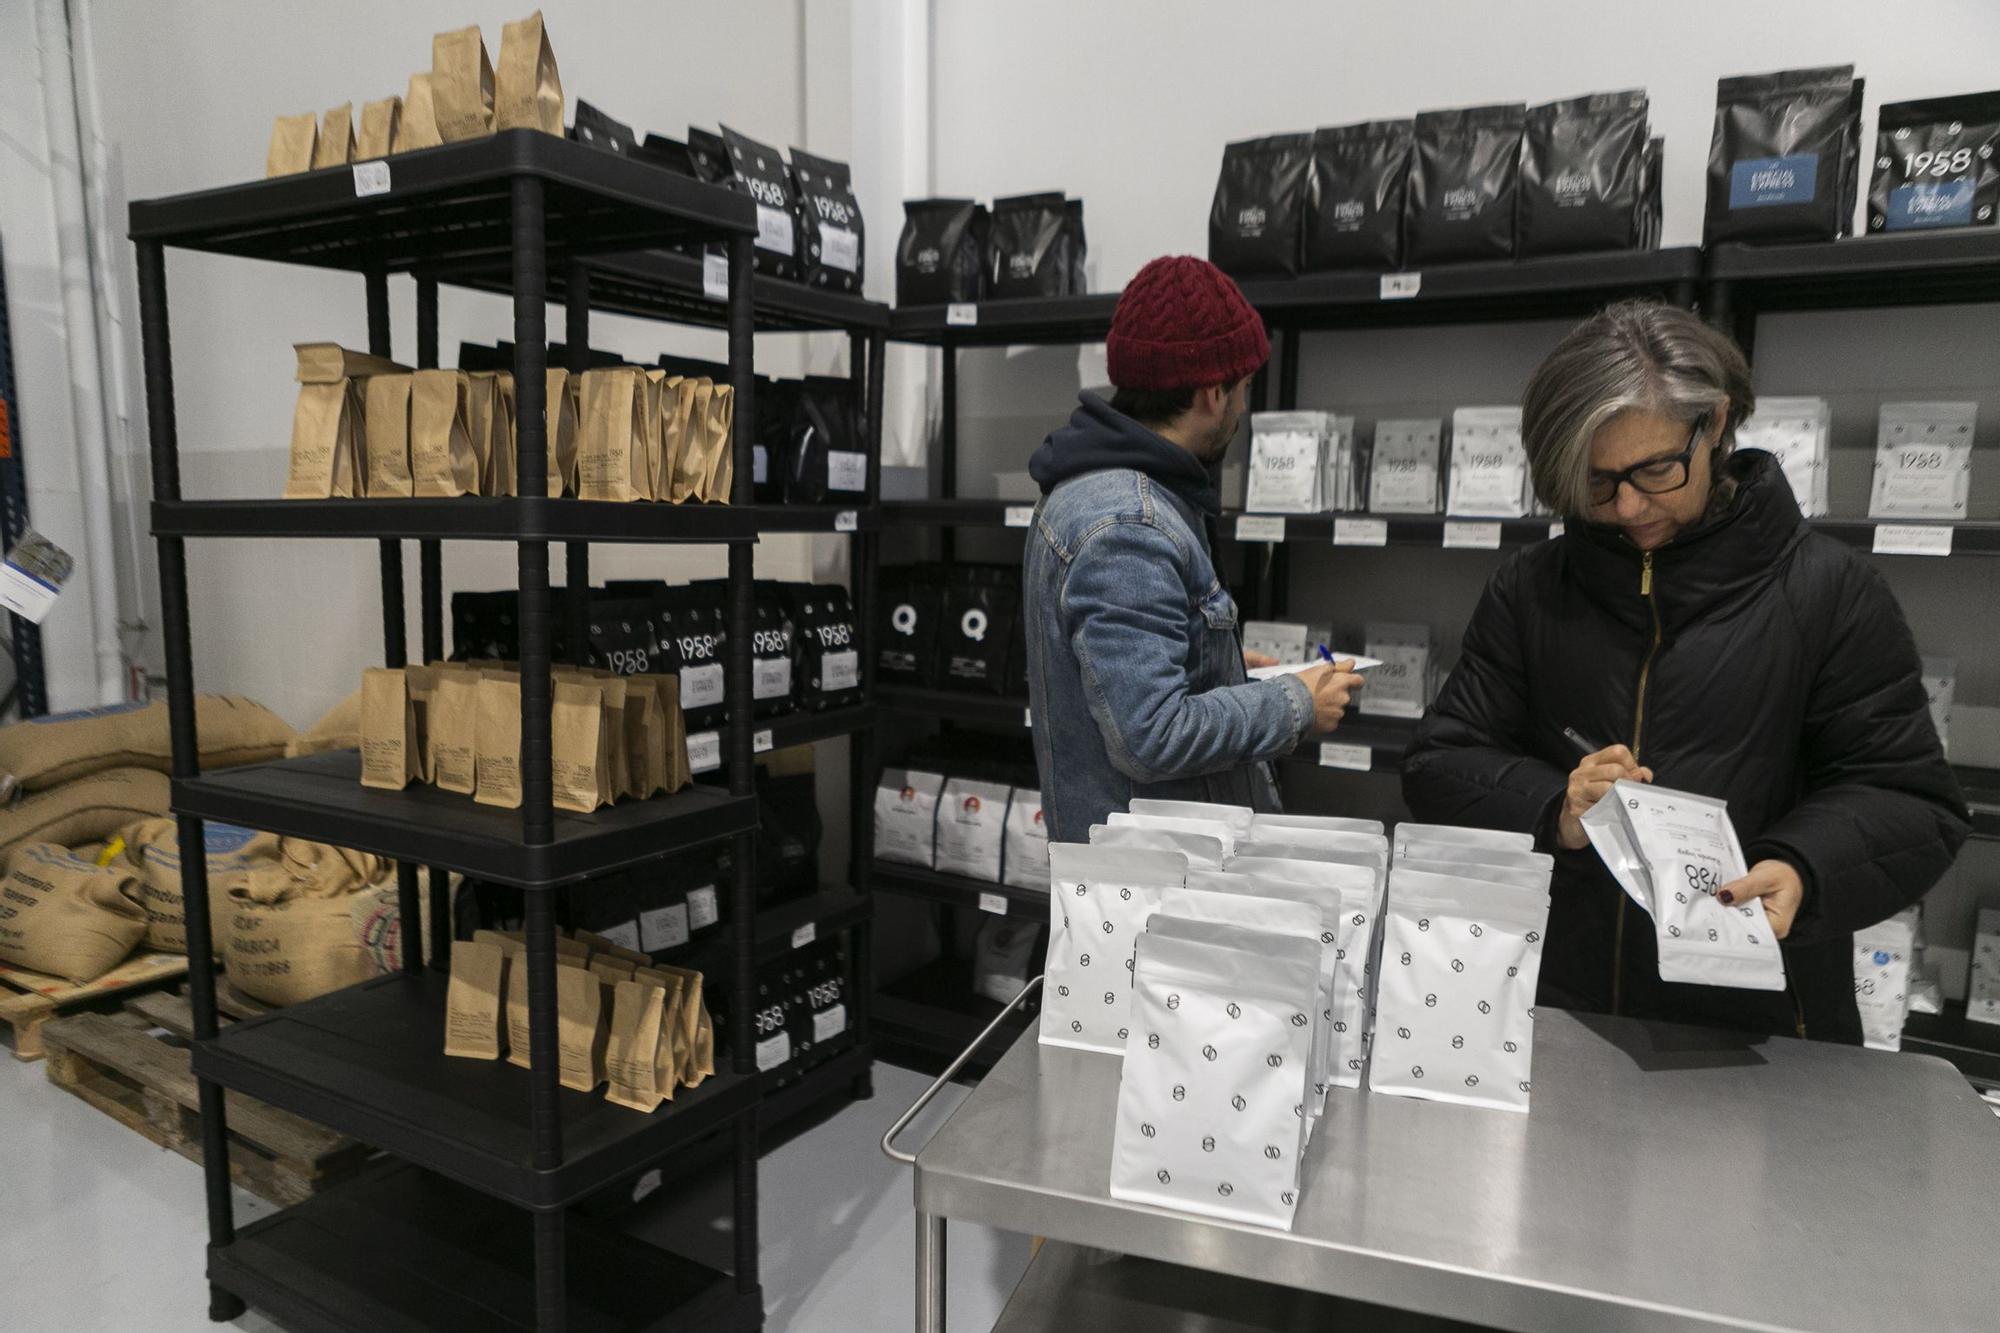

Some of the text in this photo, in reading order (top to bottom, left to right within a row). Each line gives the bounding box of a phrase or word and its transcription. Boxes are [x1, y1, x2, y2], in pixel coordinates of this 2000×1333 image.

[1904, 147, 1972, 178] 1958
[746, 176, 784, 206] 1958
[813, 195, 848, 224] 1958
[1265, 456, 1295, 471] 1958
[1389, 458, 1417, 473] 1958
[1470, 454, 1503, 469] 1958
[1900, 452, 1942, 469] 1958
[892, 604, 917, 636] Q
[961, 608, 988, 641] Q
[676, 635, 714, 660] 1958
[816, 625, 850, 647] 1958
[606, 649, 649, 674] 1958
[807, 980, 840, 1009] 1958
